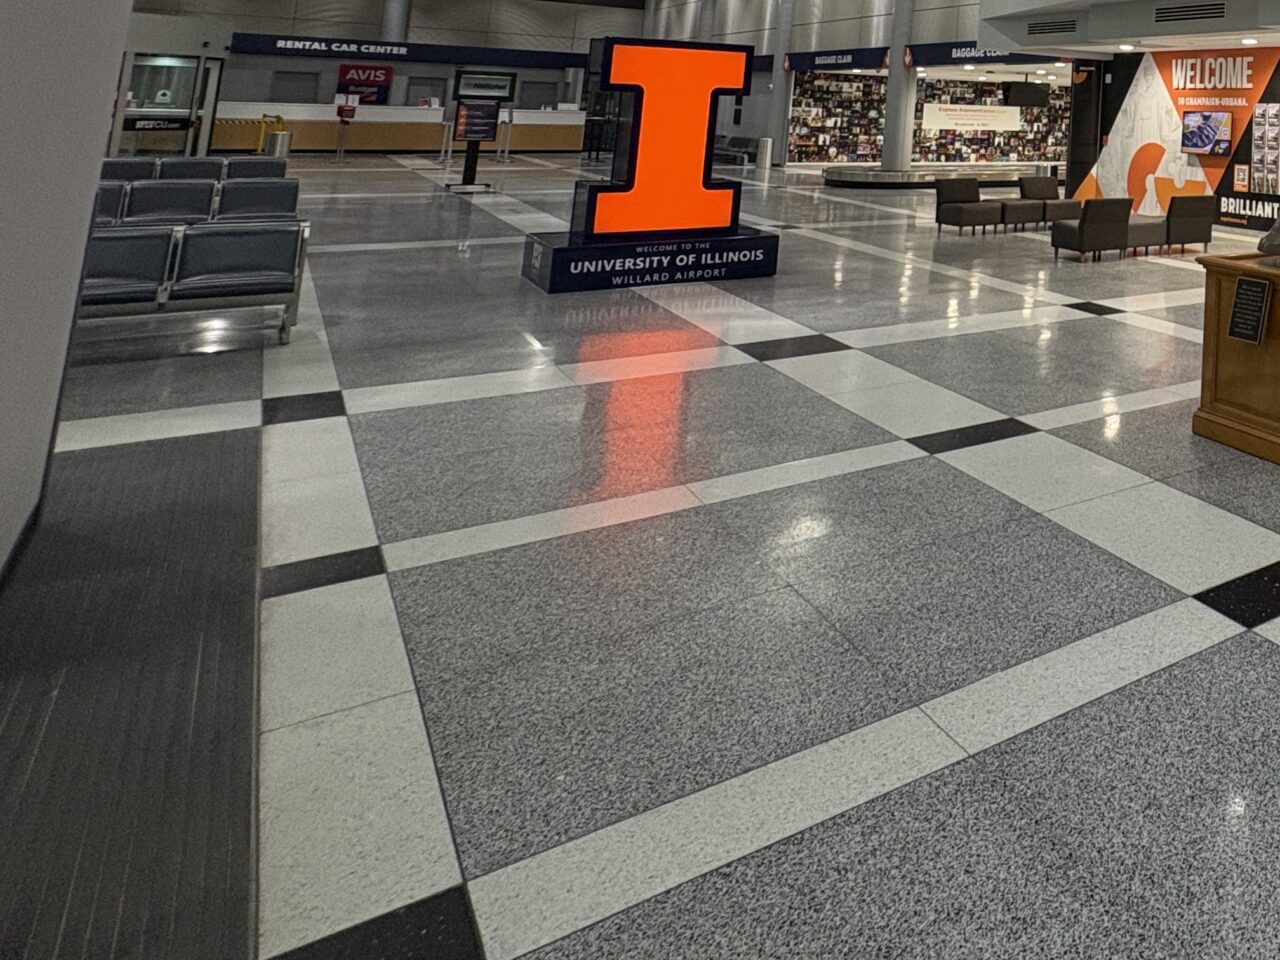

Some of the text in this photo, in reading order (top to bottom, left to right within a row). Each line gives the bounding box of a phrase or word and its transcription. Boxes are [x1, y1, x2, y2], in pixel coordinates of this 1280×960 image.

[276, 40, 408, 55] RENTAL CAR CENTER
[951, 47, 985, 59] BAGGAGE
[815, 54, 853, 65] BAGGAGE CLAIM
[345, 68, 386, 81] AVIS
[1172, 56, 1254, 90] WELCOME
[1178, 96, 1185, 106] TO
[1220, 196, 1280, 219] BRILLIANT
[635, 242, 711, 253] WELCOME TO THE
[569, 249, 765, 274] UNIVERSITY OF ILLINOIS
[611, 268, 728, 285] WILLARD AIRPORT
